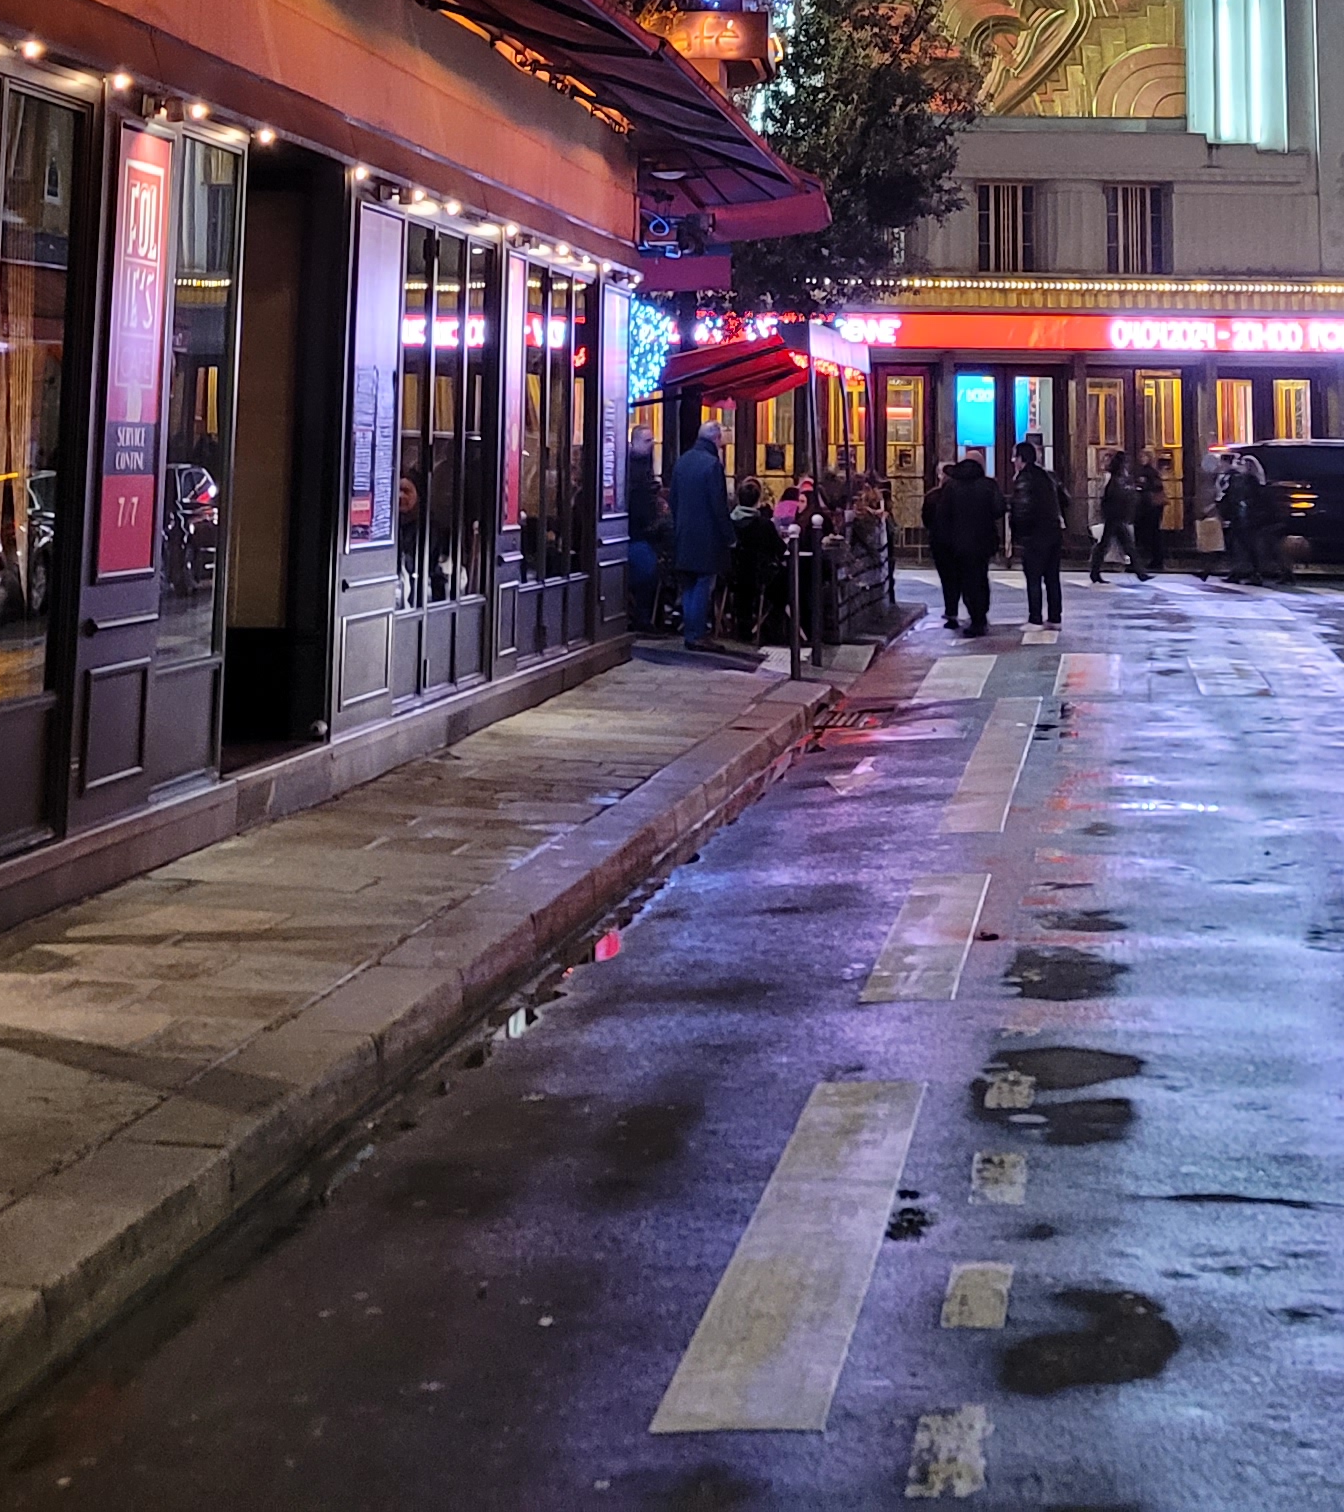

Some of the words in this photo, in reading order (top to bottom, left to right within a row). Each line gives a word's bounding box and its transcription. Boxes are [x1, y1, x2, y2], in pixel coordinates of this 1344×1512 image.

[666, 15, 740, 54] afé
[126, 180, 159, 261] FOL
[117, 426, 146, 448] SERVICE
